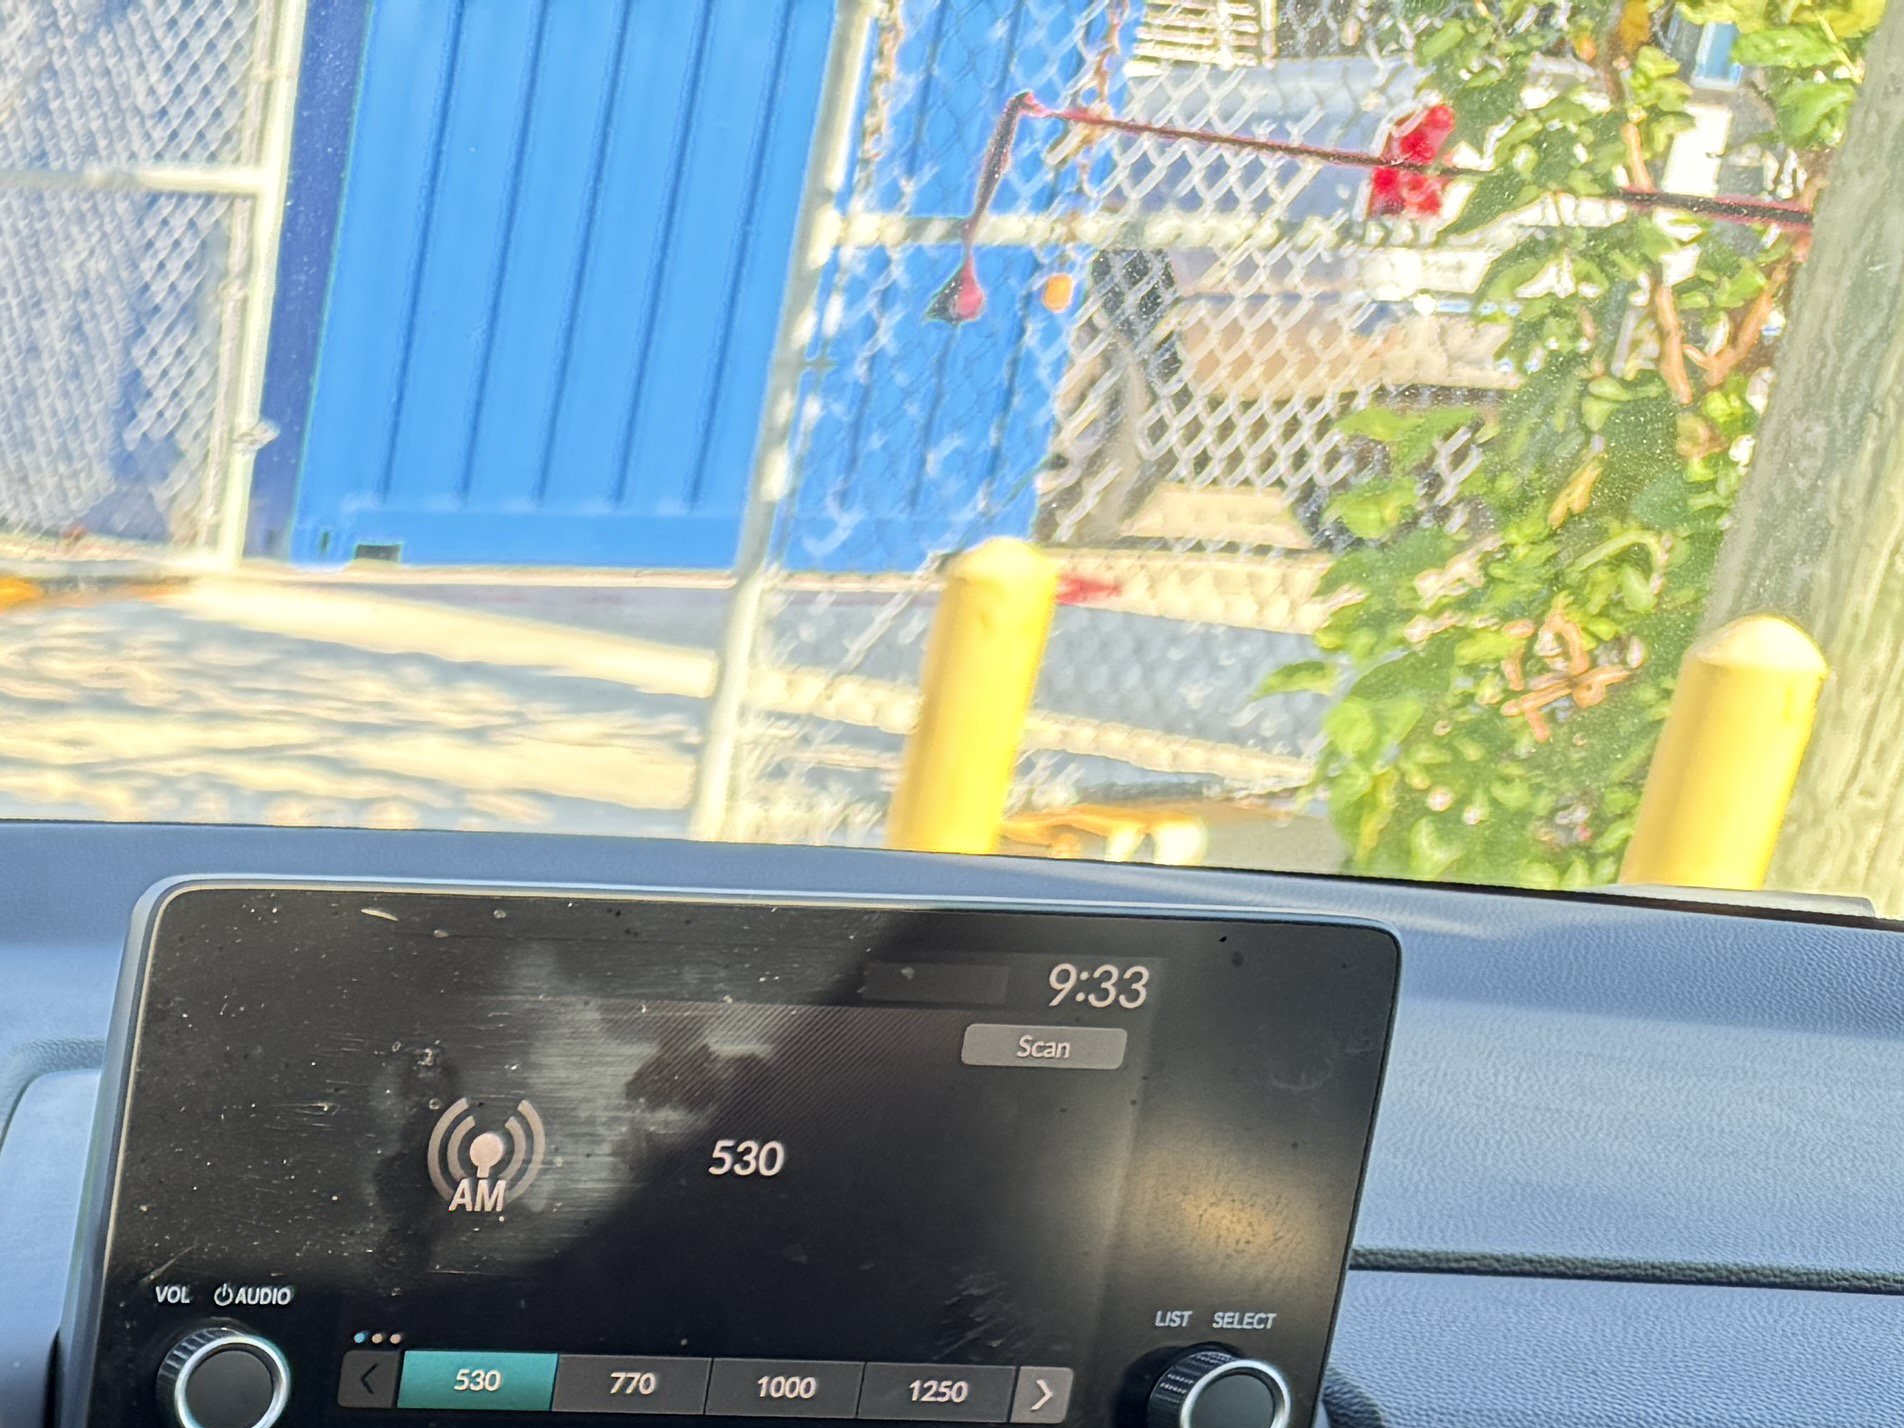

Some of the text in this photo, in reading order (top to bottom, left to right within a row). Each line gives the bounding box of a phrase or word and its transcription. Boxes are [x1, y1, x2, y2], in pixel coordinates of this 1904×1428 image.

[1048, 962, 1151, 1009] 9:33
[1016, 1034, 1071, 1059] Scan
[707, 1138, 785, 1177] 530
[448, 1177, 507, 1212] AM
[155, 1284, 191, 1305] VOL
[234, 1284, 292, 1306] AUDIO
[1154, 1310, 1193, 1328] LIST
[1212, 1312, 1277, 1330] SELECT
[453, 1368, 502, 1392] 530
[609, 1371, 657, 1395] 770
[756, 1375, 817, 1400] 1000
[908, 1379, 969, 1403] 1250
